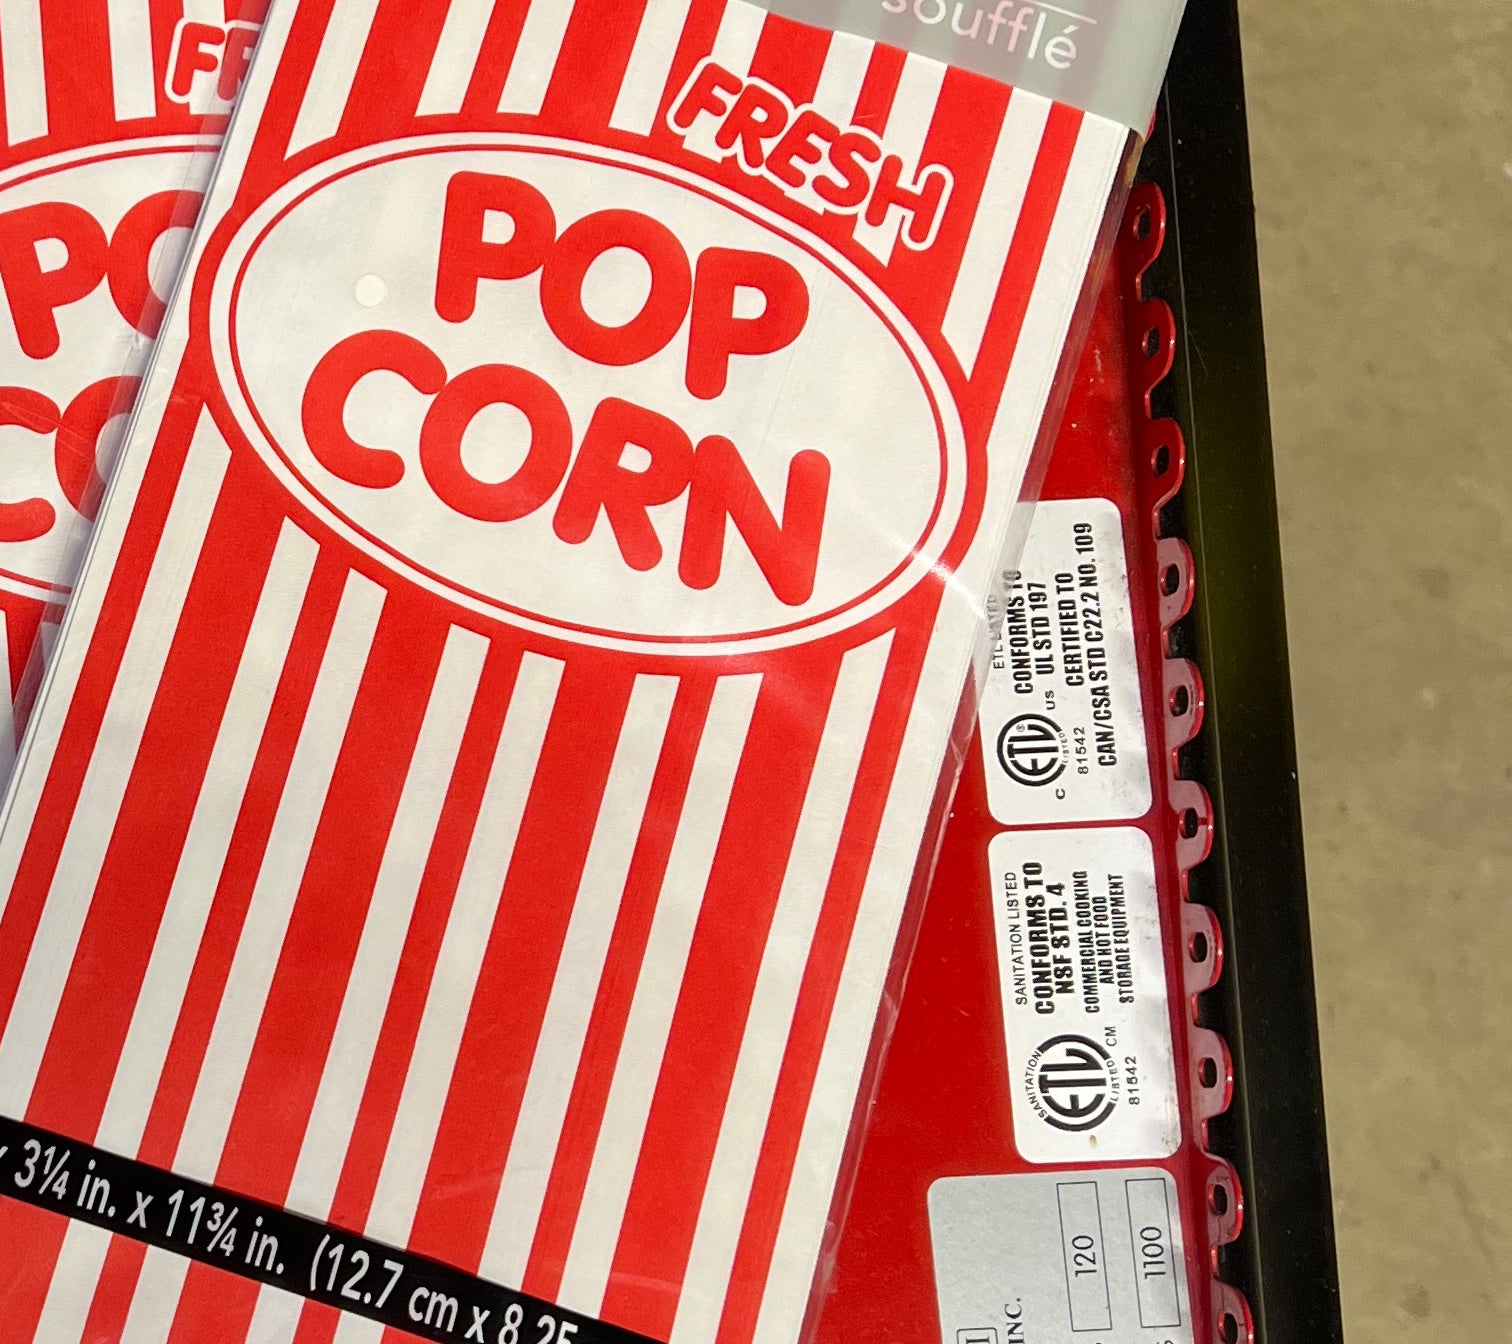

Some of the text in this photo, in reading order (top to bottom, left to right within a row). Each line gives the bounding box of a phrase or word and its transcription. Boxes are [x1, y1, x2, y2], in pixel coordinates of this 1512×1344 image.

[671, 60, 950, 246] FRESH
[435, 171, 810, 400] POP
[301, 329, 831, 607] CORN
[1002, 568, 1033, 694] CONFORMS TO
[1028, 582, 1055, 676] UL STD 197
[1055, 572, 1085, 687] CERTIFIED TO
[1073, 522, 1118, 767] CAN/CSA STD C22.2 NO. 109
[1044, 689, 1056, 710] US
[1073, 726, 1089, 775] 81542
[1005, 871, 1028, 1006] SANITATION LISTED
[1022, 862, 1056, 1015] CONFORMS TO
[1046, 882, 1075, 994] NSF STD. 4
[1073, 870, 1100, 1014] COMMERCIAL COOKING
[1092, 896, 1115, 985] AND HOT FOOD
[1108, 874, 1135, 1004] STORAGE EQUIPMENT
[1025, 1050, 1047, 1118] SANITATION
[1105, 1025, 1117, 1047] CM
[1106, 1059, 1119, 1102] LISTED
[77, 1159, 116, 1217] in.
[127, 1191, 154, 1228] x
[245, 1216, 285, 1275] in.
[309, 1234, 404, 1309] (12.7
[407, 1286, 459, 1333] cm
[464, 1305, 491, 1344] x
[1073, 1234, 1097, 1277] 120
[1140, 1226, 1168, 1278] 1100
[1004, 1297, 1025, 1344] INC.
